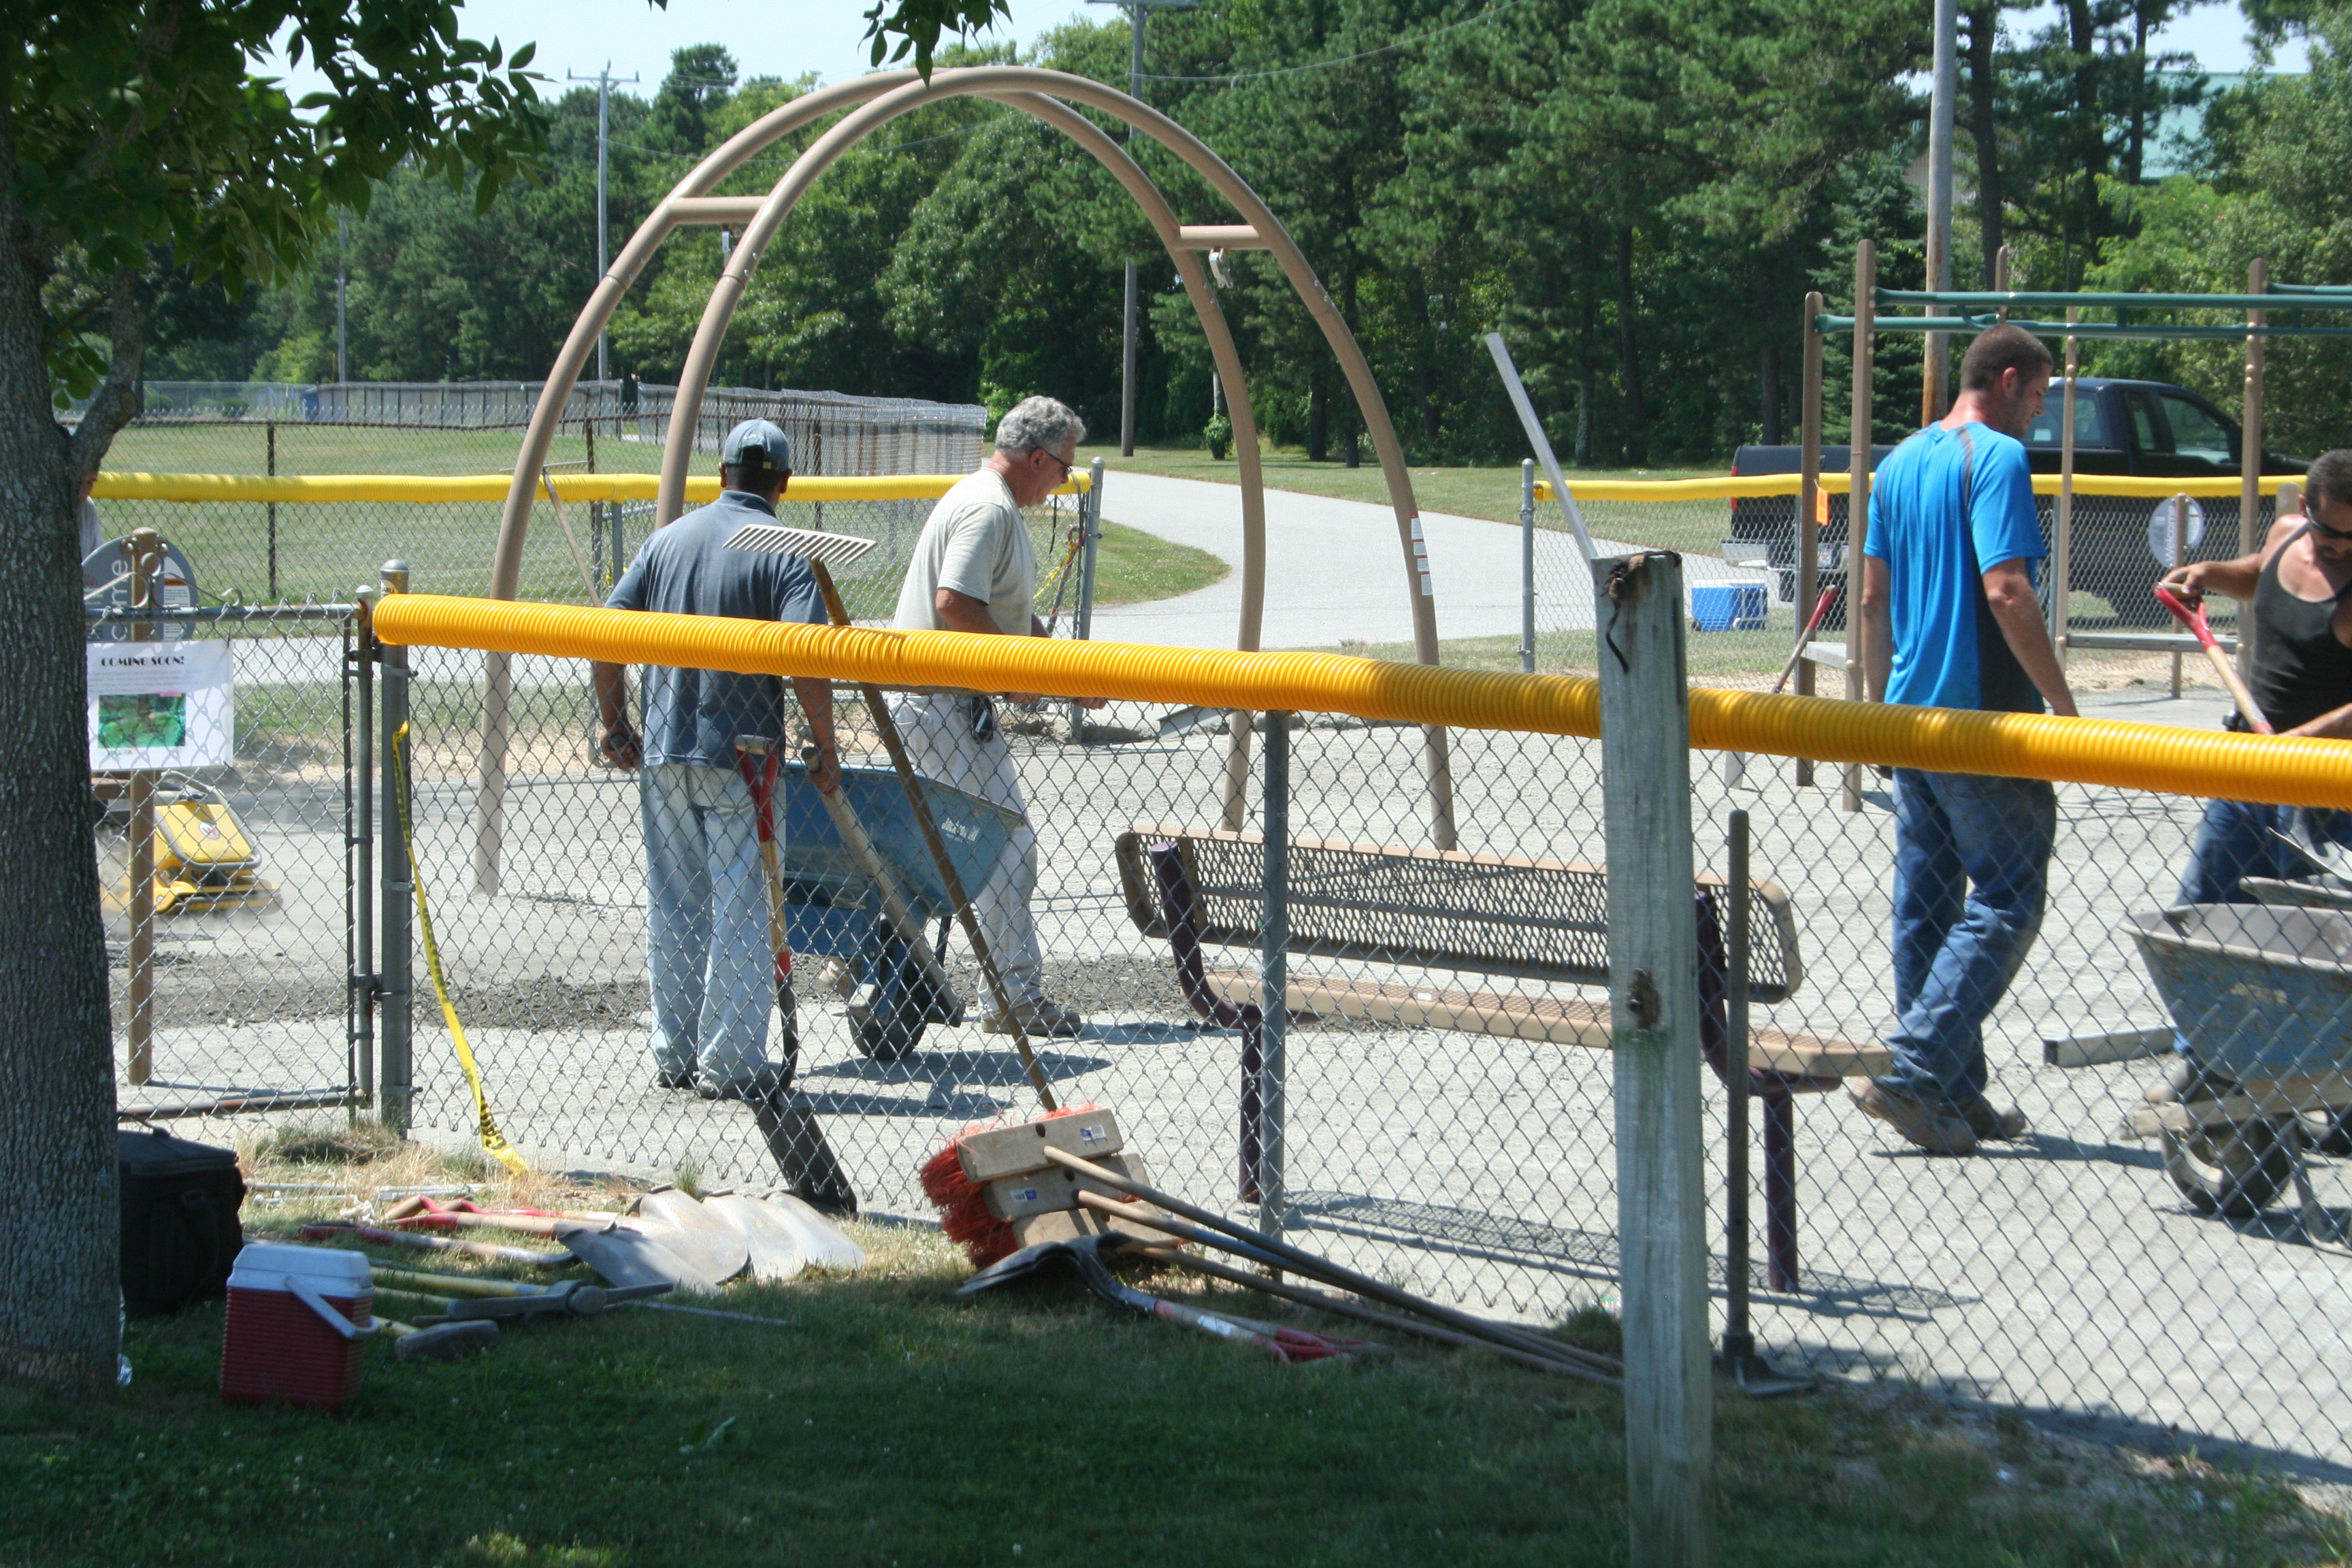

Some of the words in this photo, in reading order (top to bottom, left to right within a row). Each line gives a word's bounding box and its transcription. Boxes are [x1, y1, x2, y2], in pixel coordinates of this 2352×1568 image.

[2165, 505, 2175, 561] Welcome
[101, 656, 148, 667] COMING
[151, 655, 184, 666] SOON!
